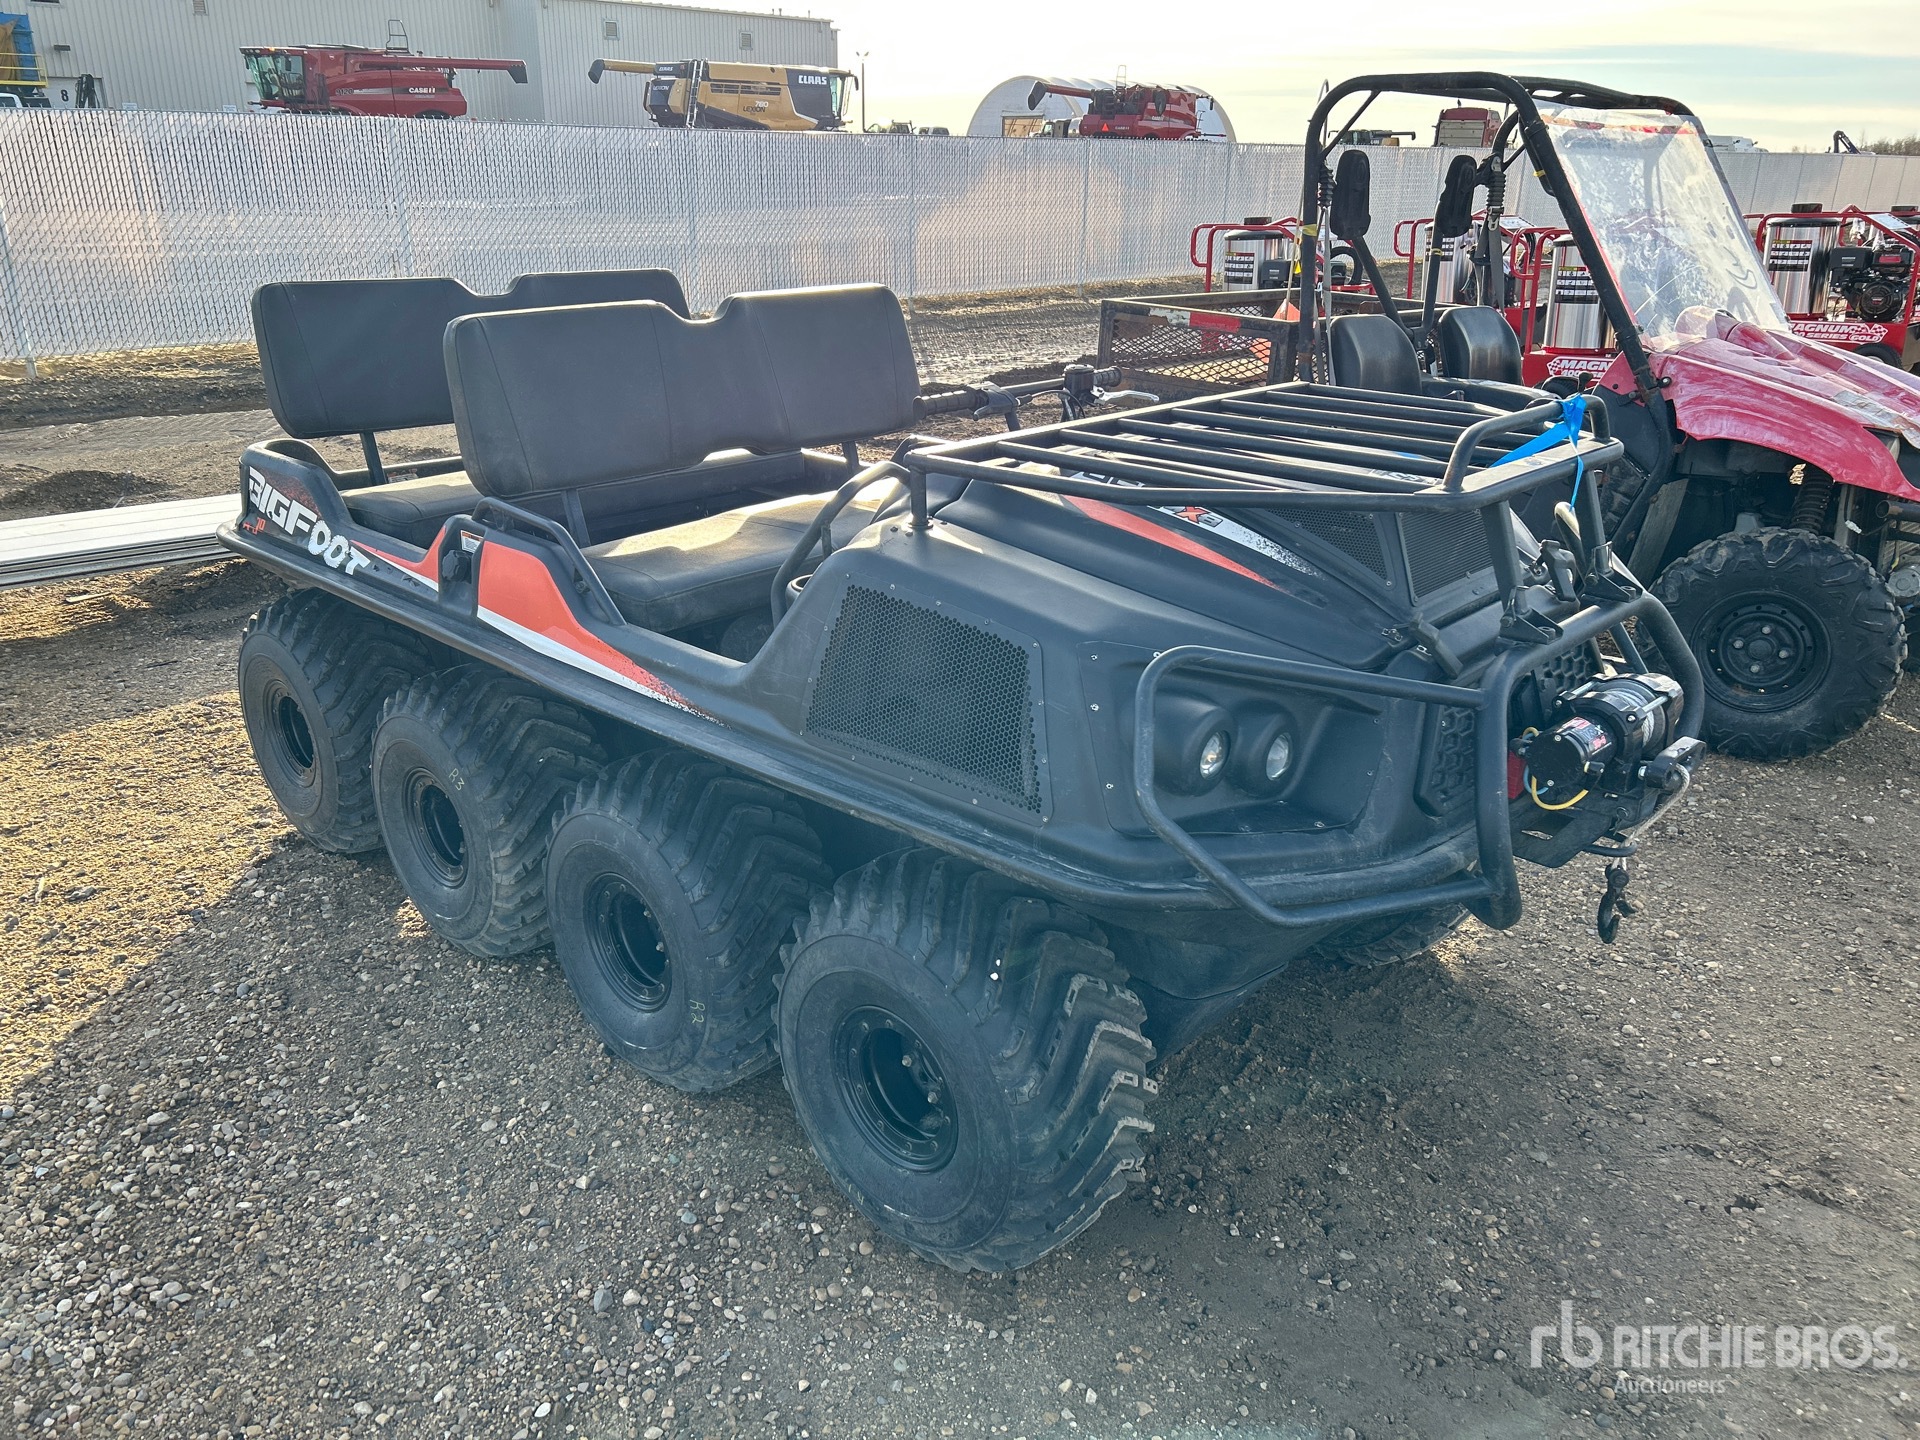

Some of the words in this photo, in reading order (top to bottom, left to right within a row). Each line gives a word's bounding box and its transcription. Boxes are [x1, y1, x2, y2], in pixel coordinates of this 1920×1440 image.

[798, 74, 828, 85] CLAAS
[60, 89, 69, 102] 8
[408, 86, 429, 94] CASE
[742, 105, 766, 113] LEXION
[1788, 322, 1858, 334] AGNUM
[1806, 332, 1849, 340] SERIES
[1560, 359, 1611, 371] MAGN
[249, 465, 371, 576] BIGFOOT
[448, 767, 465, 791] R3
[689, 999, 706, 1024] R2
